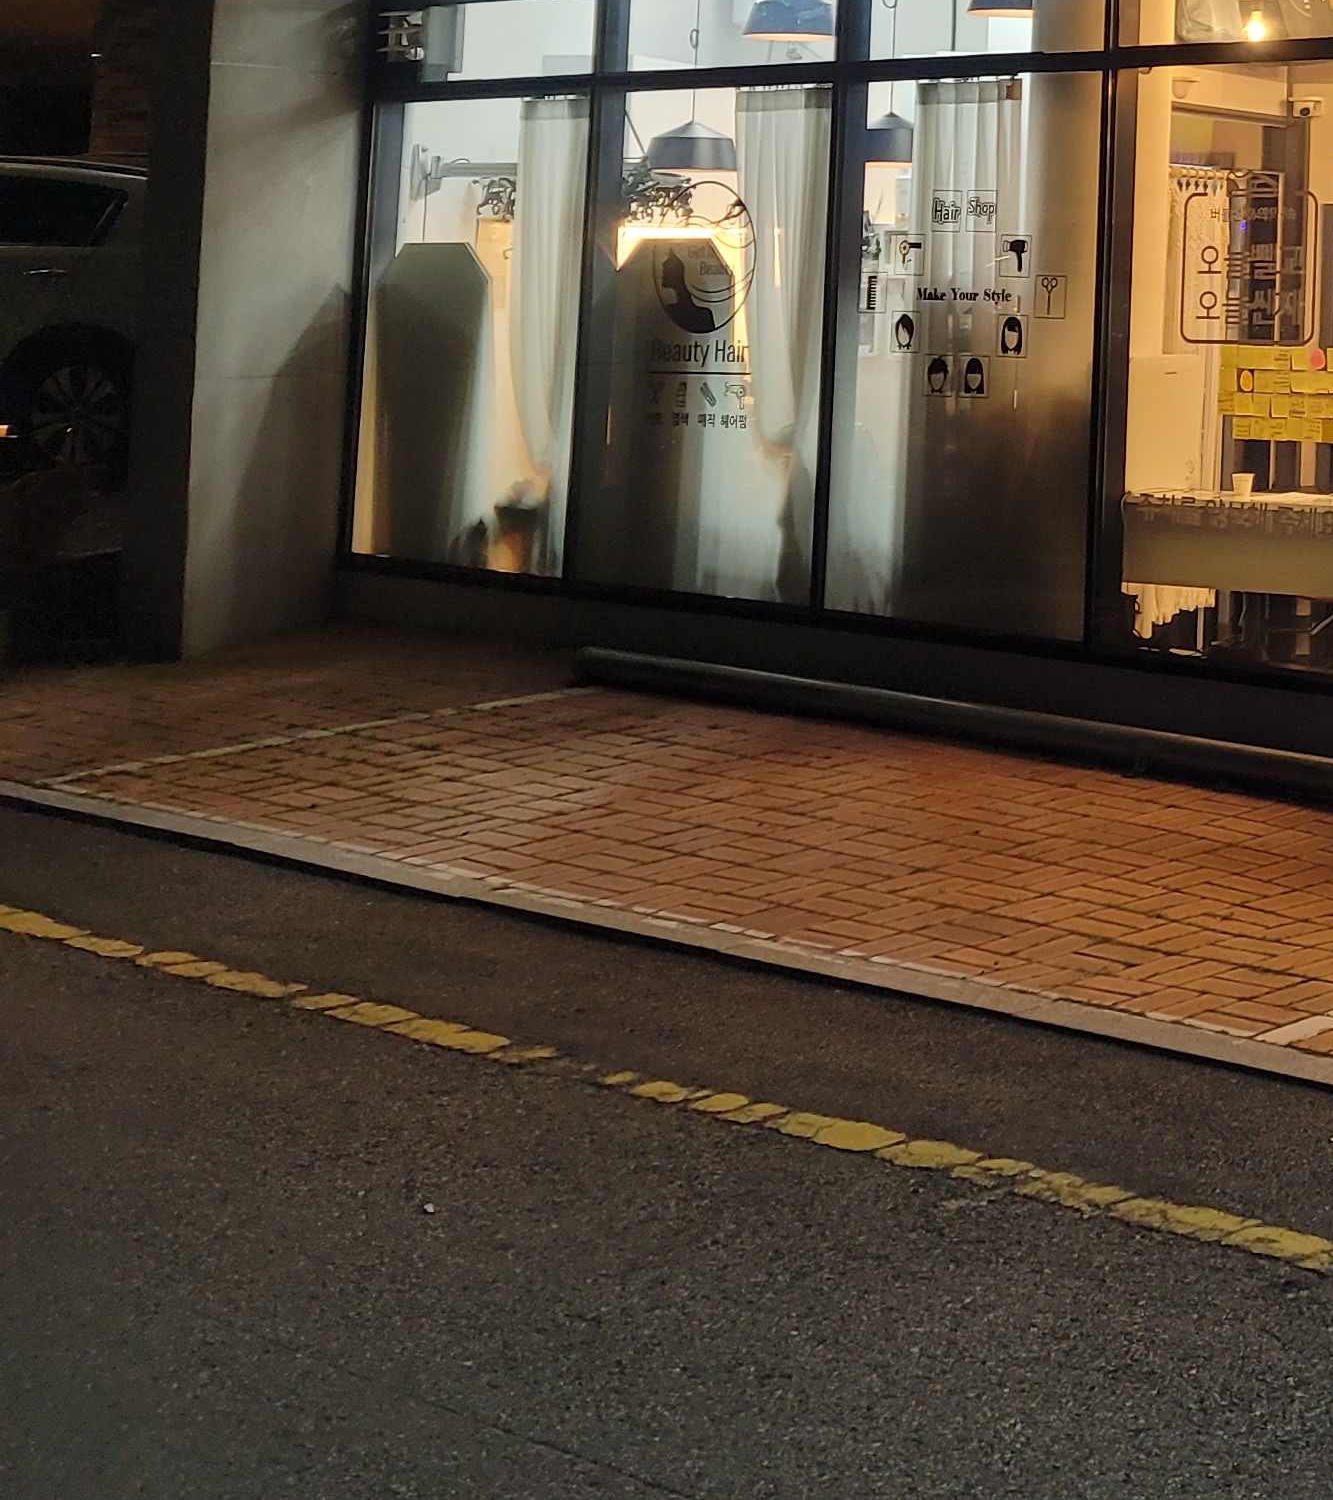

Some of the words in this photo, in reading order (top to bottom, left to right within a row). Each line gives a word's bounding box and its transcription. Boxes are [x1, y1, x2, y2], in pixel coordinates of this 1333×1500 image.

[933, 197, 962, 224] Hair
[967, 196, 996, 225] Shop
[916, 287, 947, 302] Make
[951, 287, 979, 302] Your
[983, 287, 1012, 306] Style
[650, 338, 711, 368] Beauty
[713, 338, 750, 363] Hair
